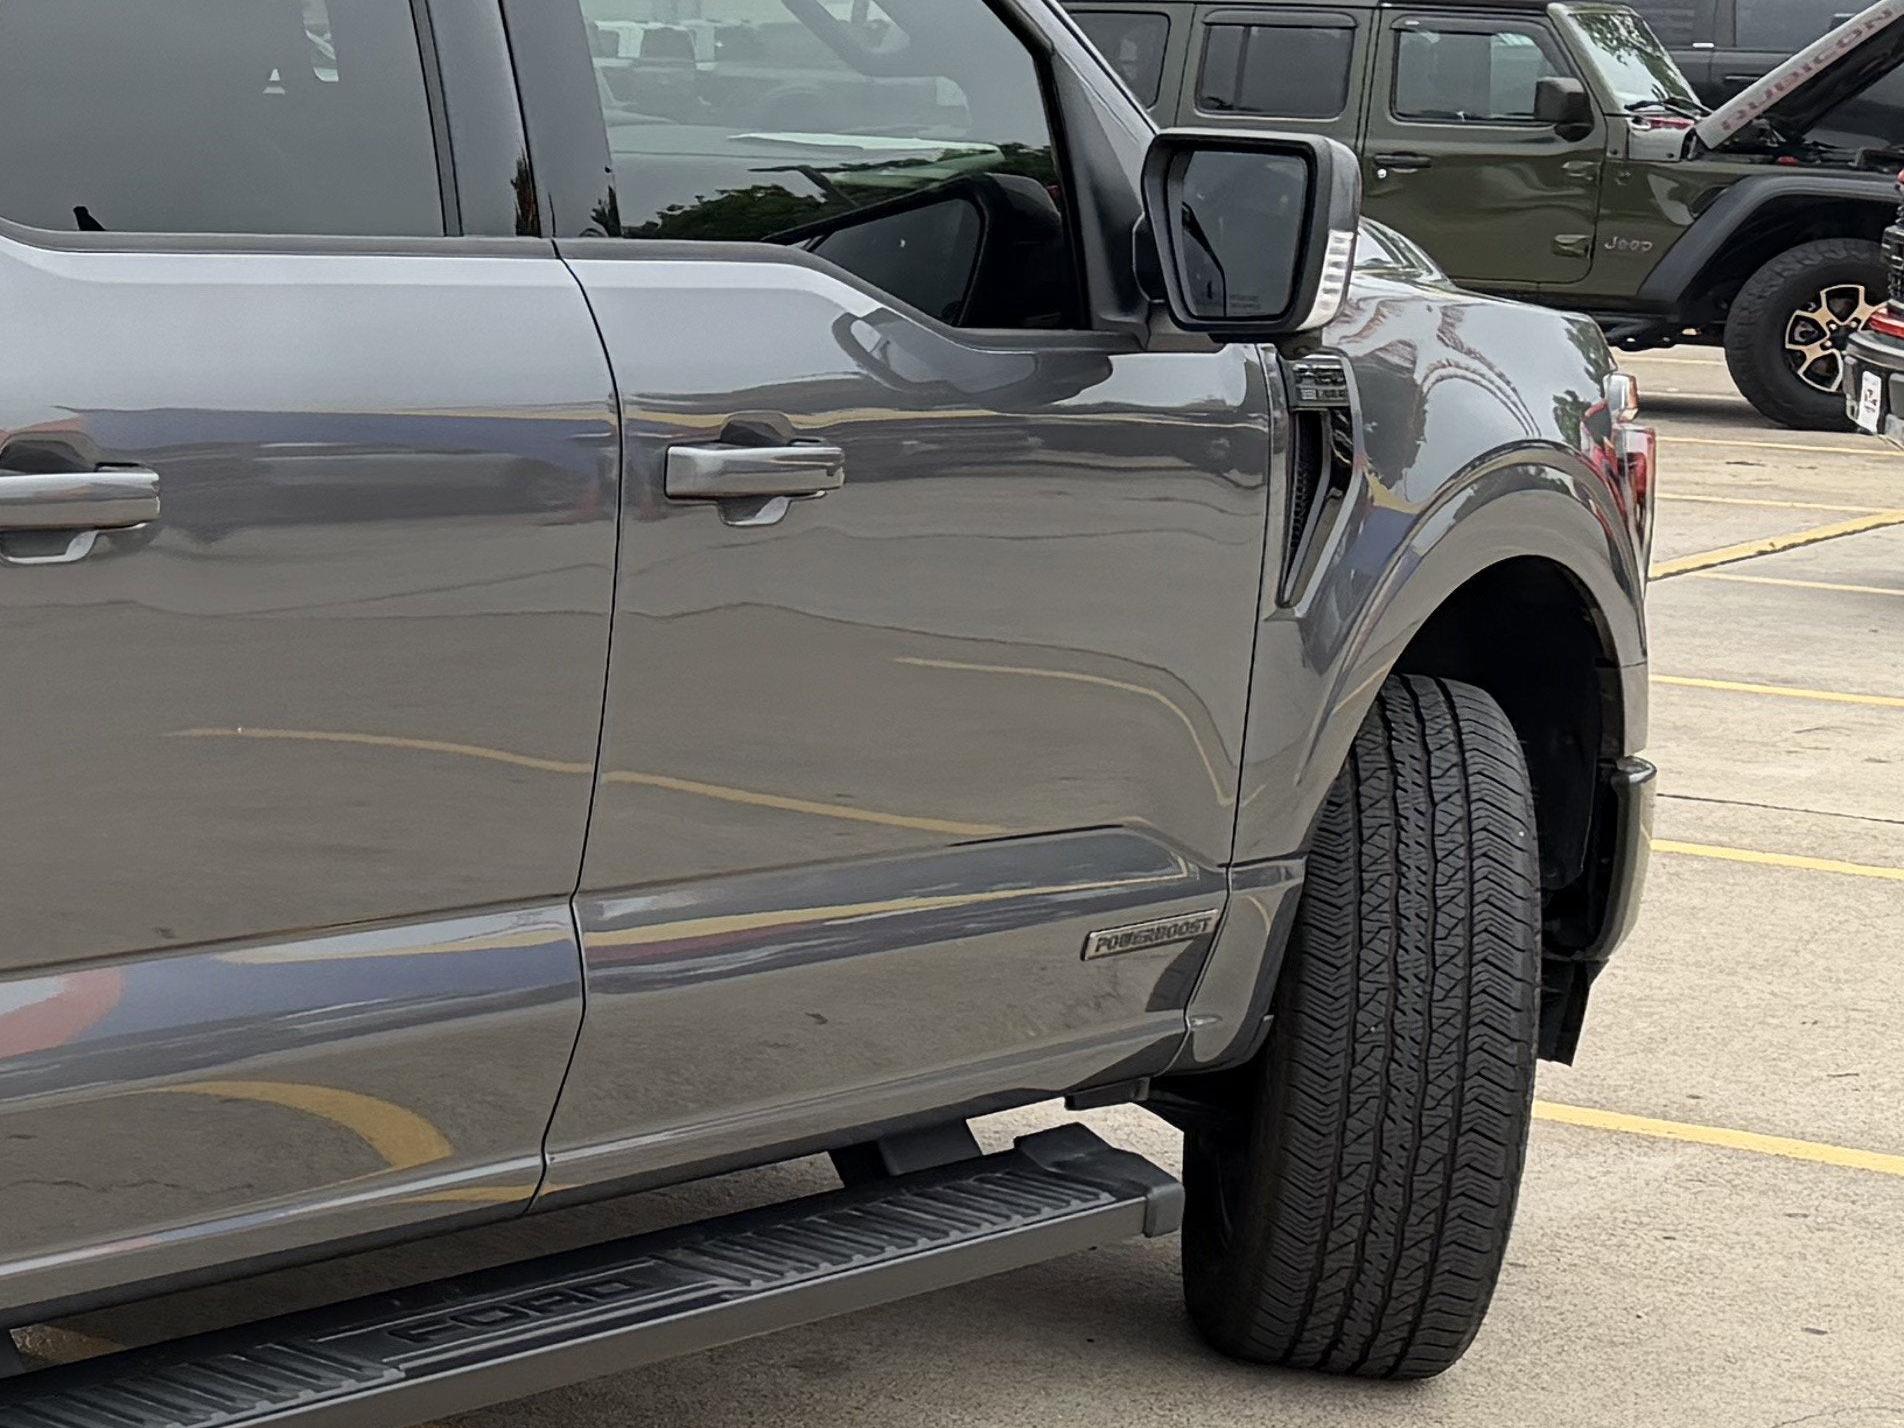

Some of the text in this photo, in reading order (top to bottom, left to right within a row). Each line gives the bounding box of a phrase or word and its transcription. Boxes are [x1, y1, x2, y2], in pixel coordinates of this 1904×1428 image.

[1603, 236, 1654, 252] Jeep
[1094, 917, 1213, 953] POWERBOOST
[386, 1277, 645, 1345] FORD
